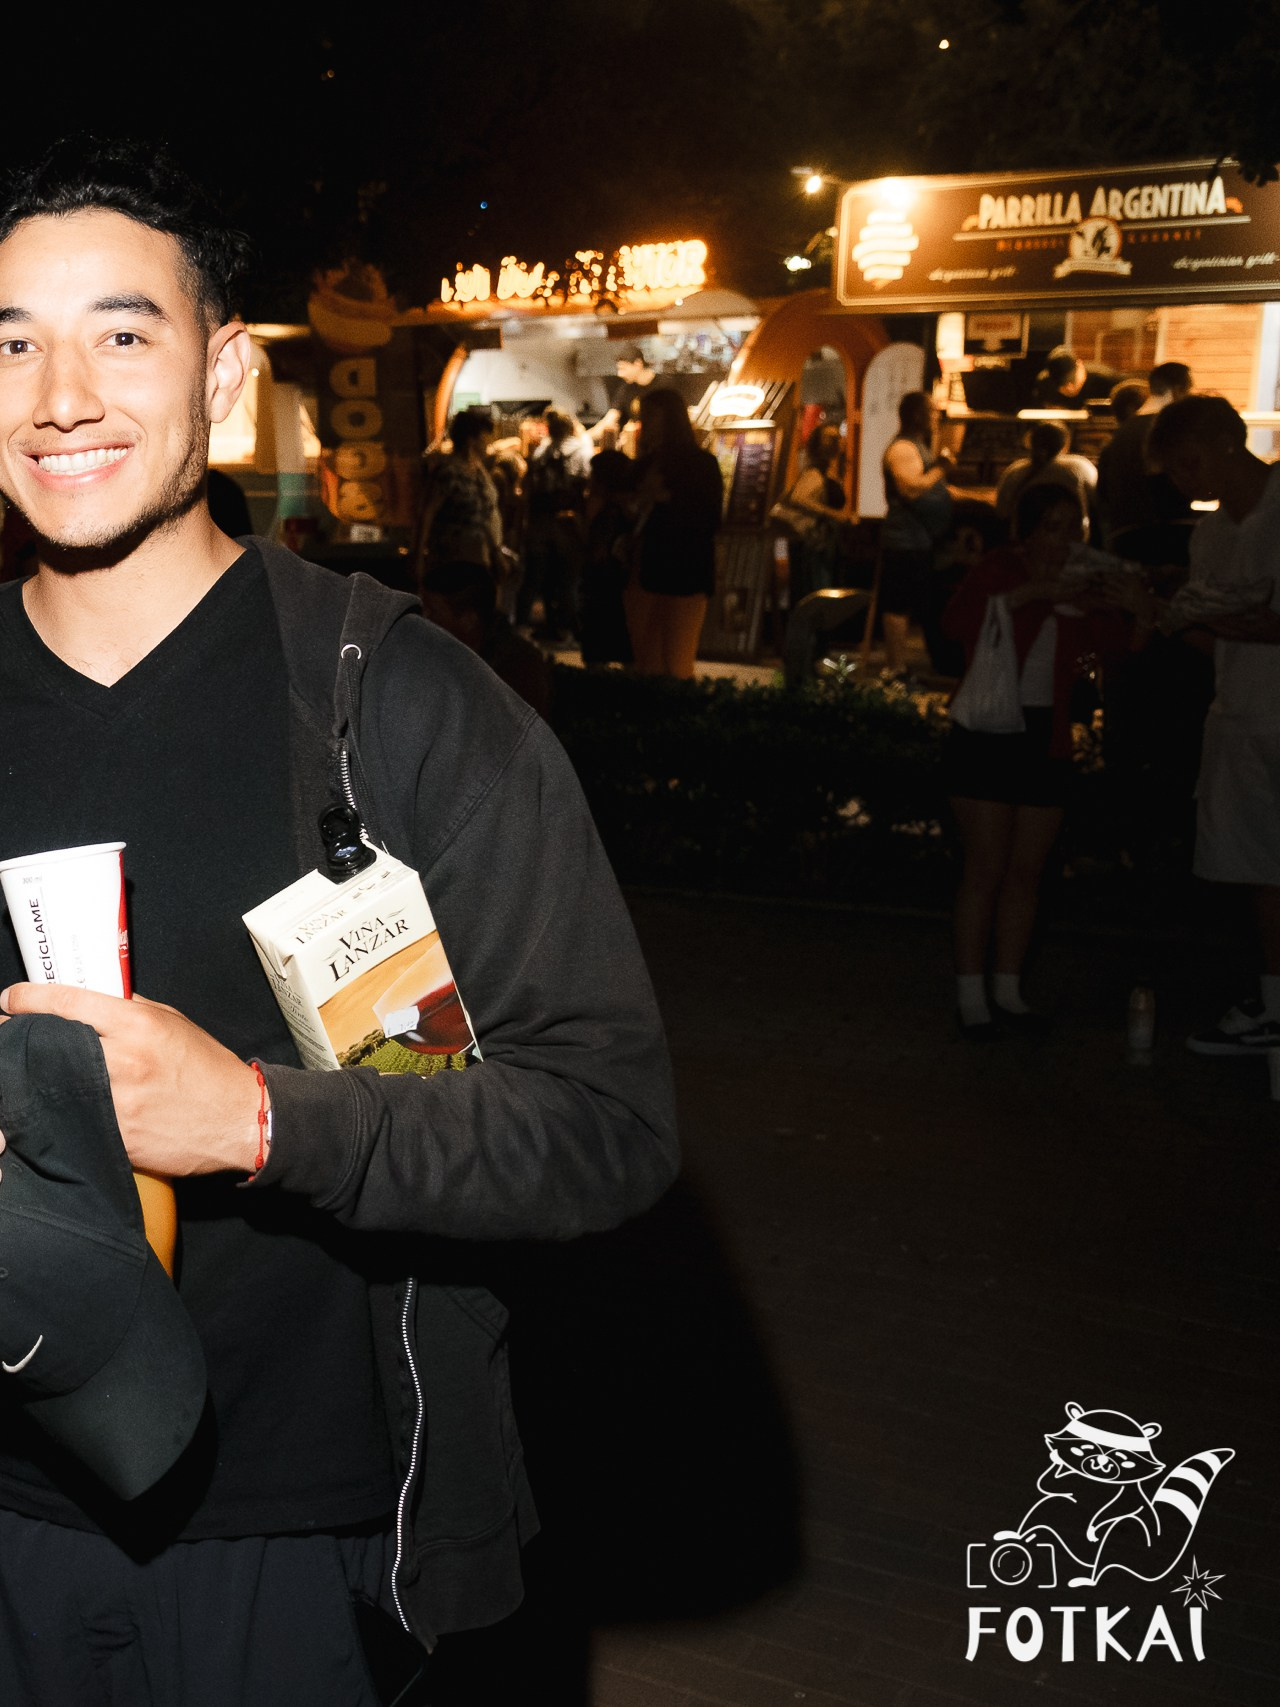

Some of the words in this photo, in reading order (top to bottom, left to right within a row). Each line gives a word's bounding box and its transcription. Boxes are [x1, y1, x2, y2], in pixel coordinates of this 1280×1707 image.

[978, 191, 1082, 230] PARRILLA
[1088, 175, 1227, 221] ARGENTINA
[29, 898, 56, 985] ECÍCLAME
[328, 918, 410, 983] LANZAR
[338, 915, 385, 950] VIÑA
